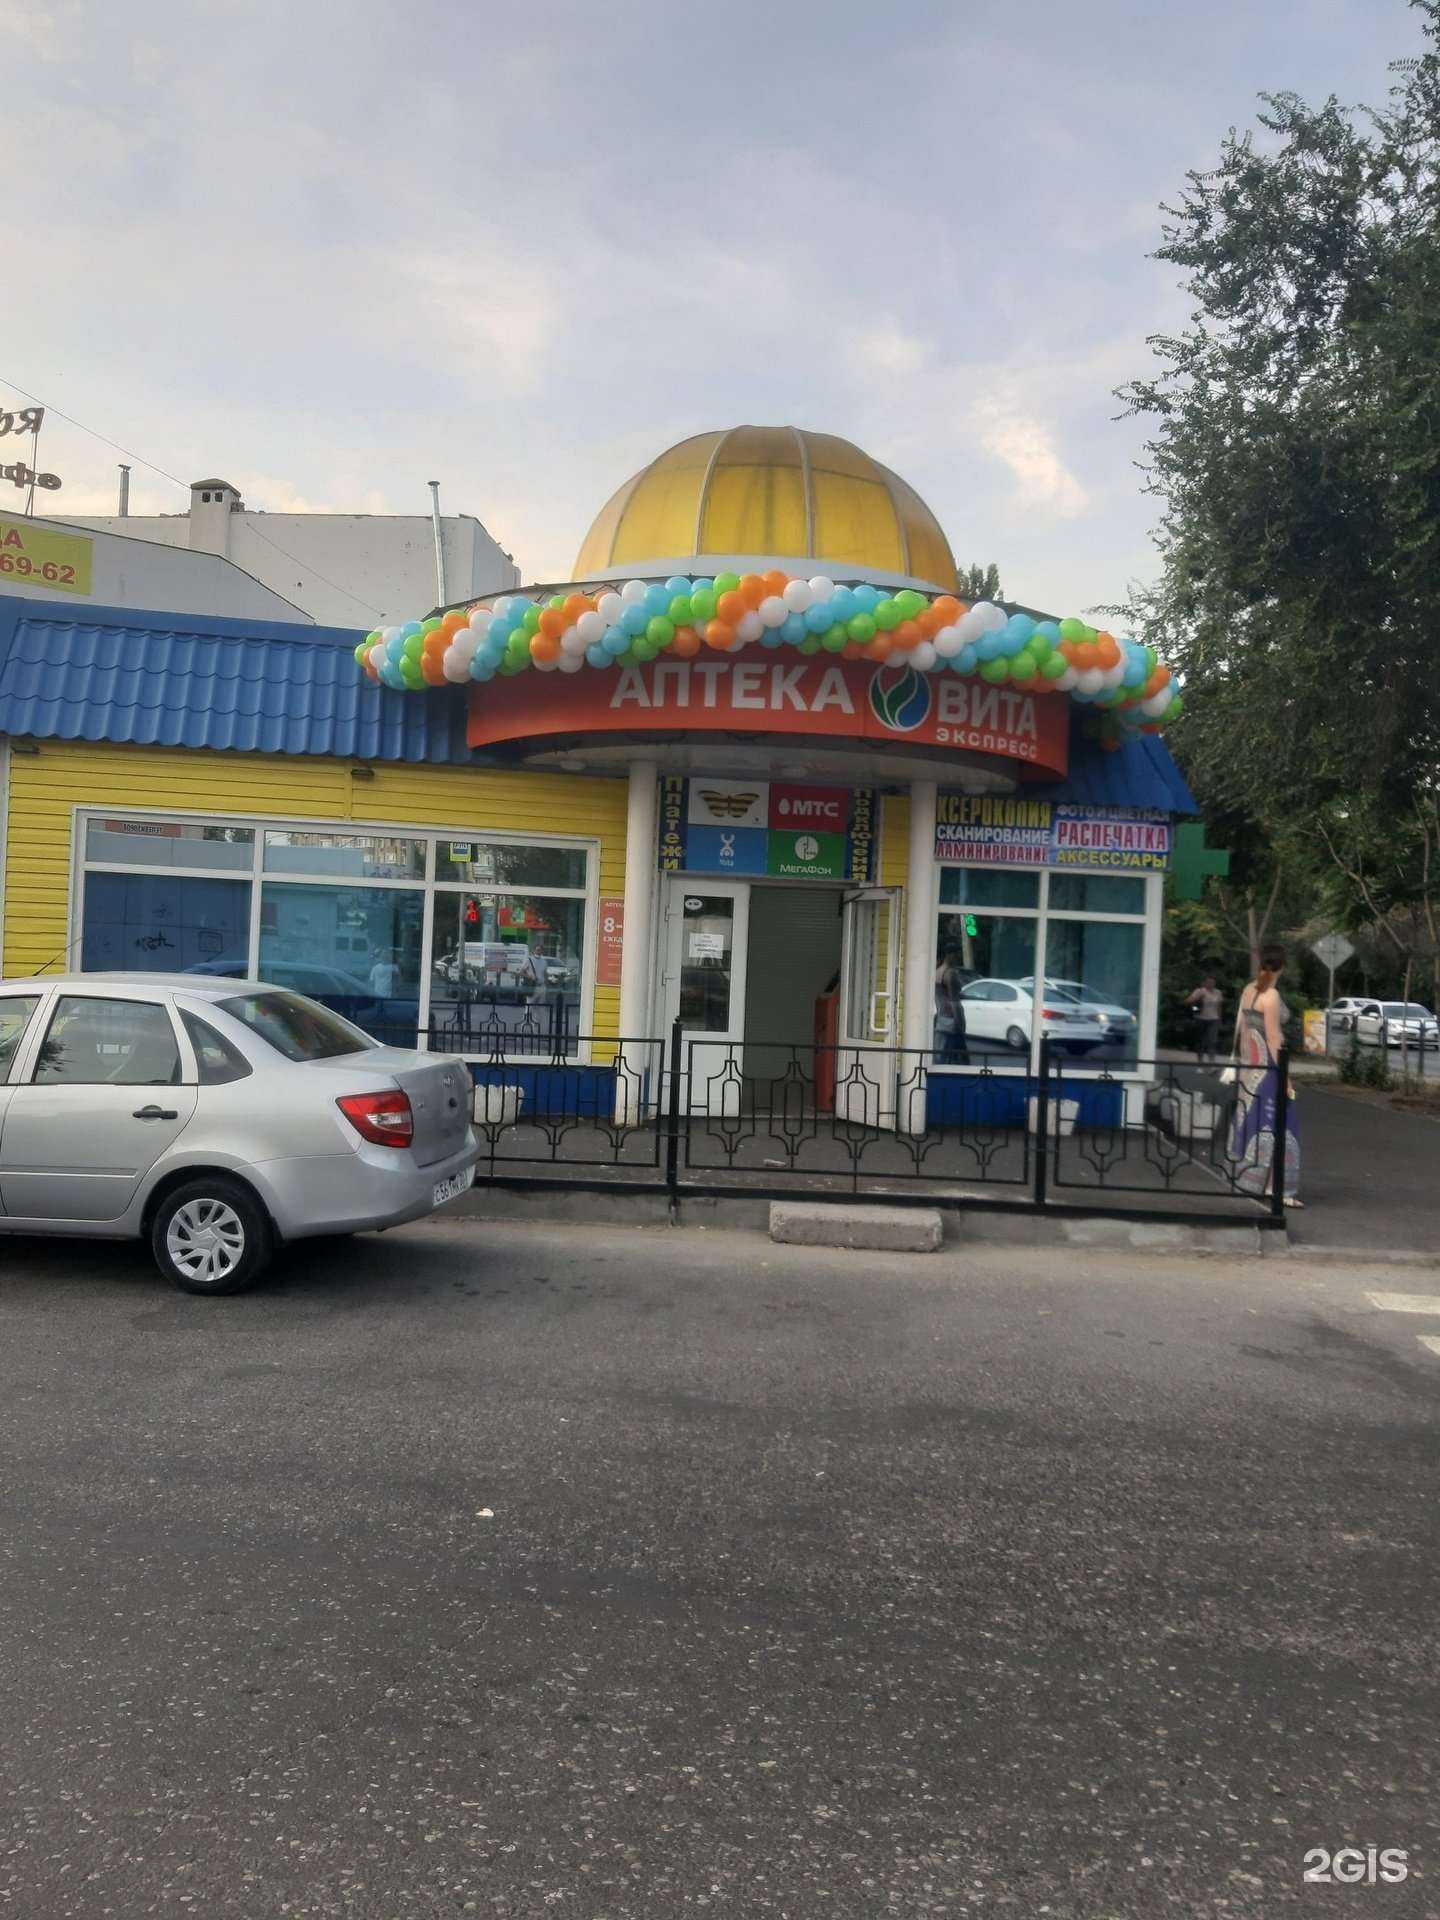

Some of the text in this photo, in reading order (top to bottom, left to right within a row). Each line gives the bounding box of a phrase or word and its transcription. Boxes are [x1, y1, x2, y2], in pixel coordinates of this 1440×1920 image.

[609, 662, 855, 714] АПТЕКА
[938, 679, 1037, 740] ВИТА
[935, 727, 1038, 758] ЭКСПРЕСС
[792, 800, 840, 817] МТС
[937, 795, 1051, 828] КСЕРОКОПИЯ
[936, 825, 1051, 845] СКАНИРОВАНИЕ
[1056, 821, 1167, 851] РАСПЕЧАТКА
[1056, 849, 1168, 868] АКСЕССУАРЫ
